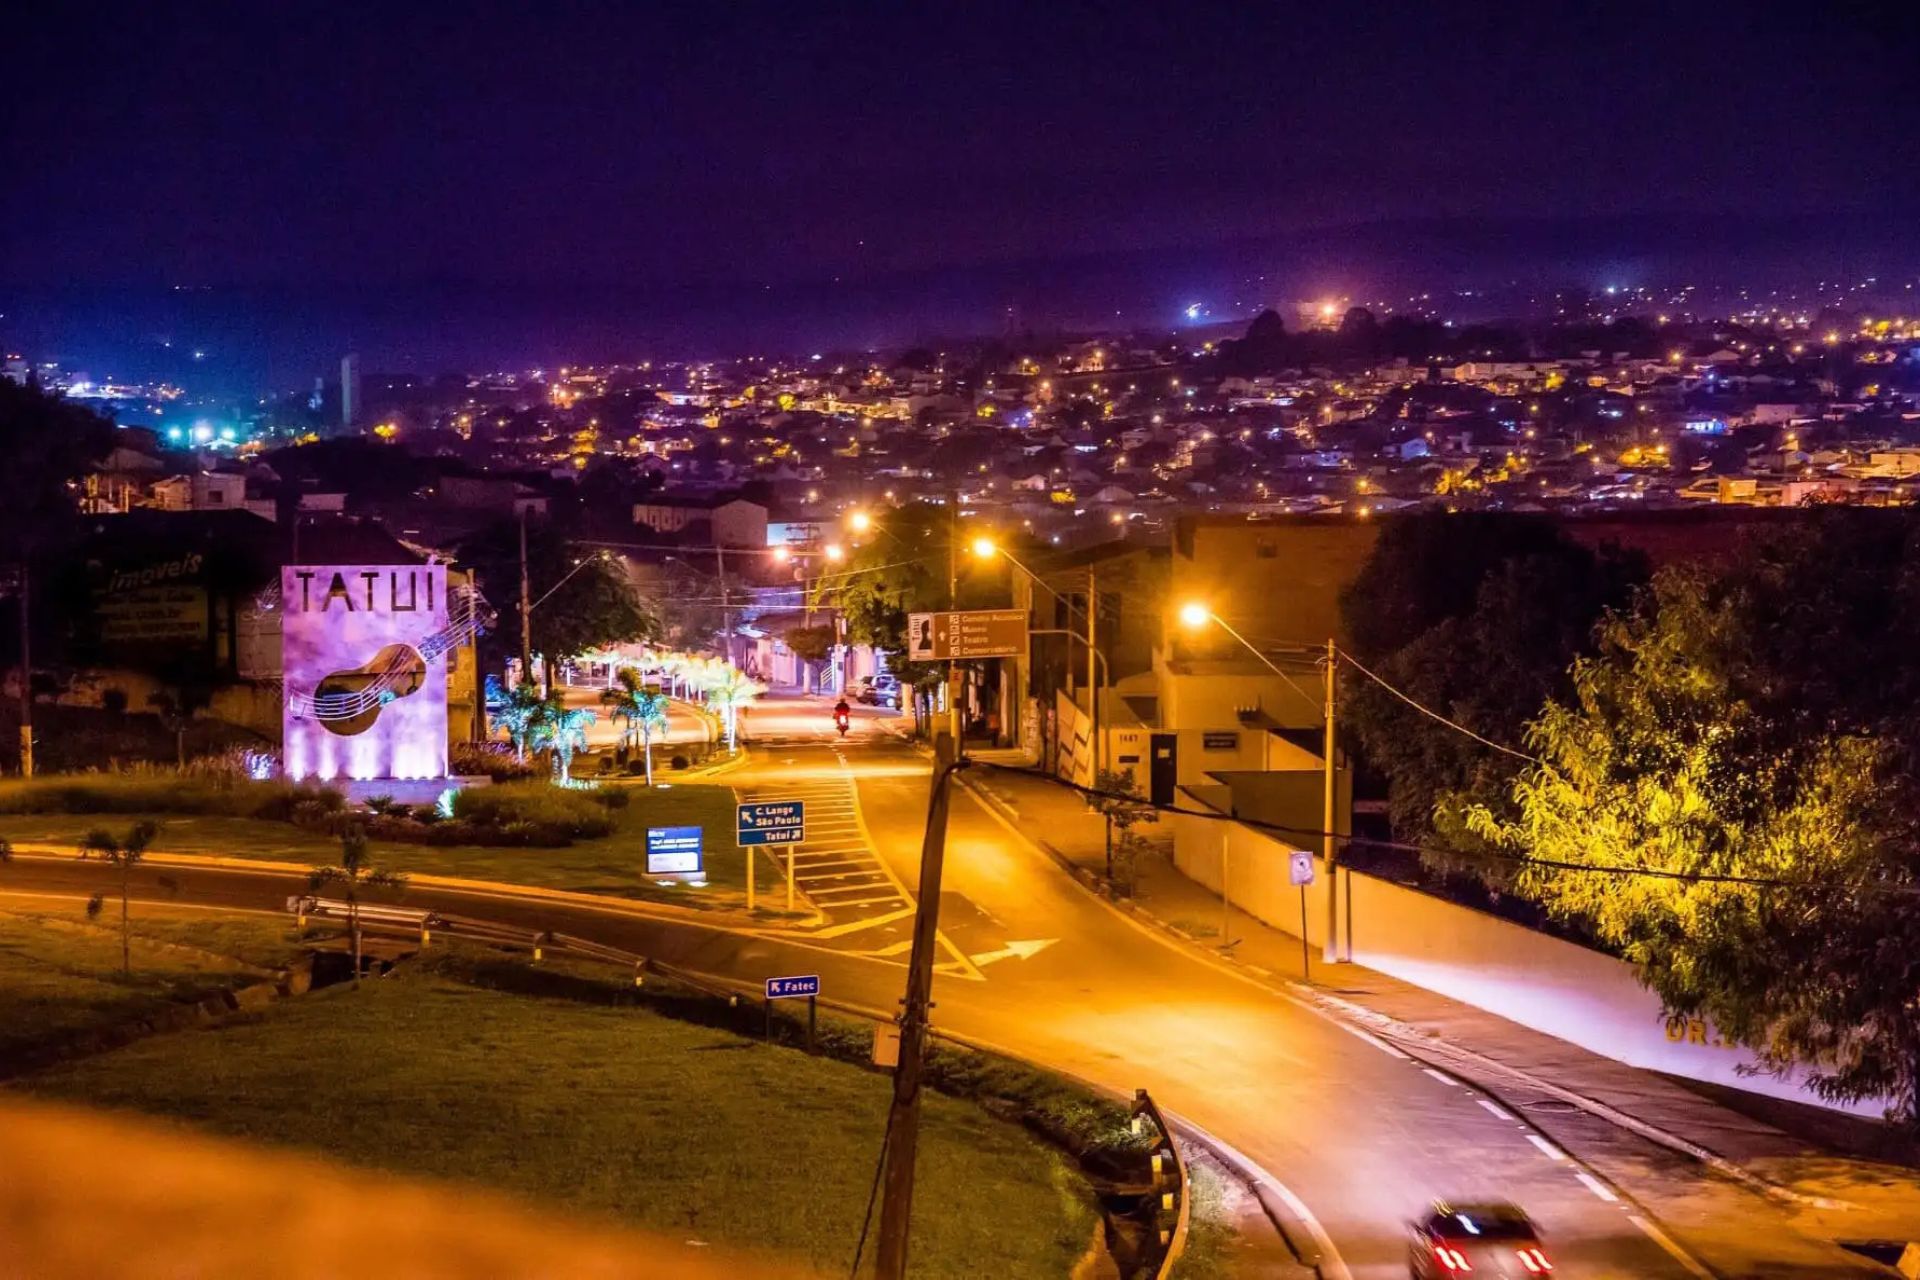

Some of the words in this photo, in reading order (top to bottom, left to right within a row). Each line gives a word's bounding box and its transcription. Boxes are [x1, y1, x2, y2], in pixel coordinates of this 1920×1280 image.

[295, 571, 433, 612] TATUI
[765, 806, 793, 815] Lange
[755, 817, 773, 826] São
[775, 816, 801, 825] Paulo
[785, 982, 815, 991] Fatec
